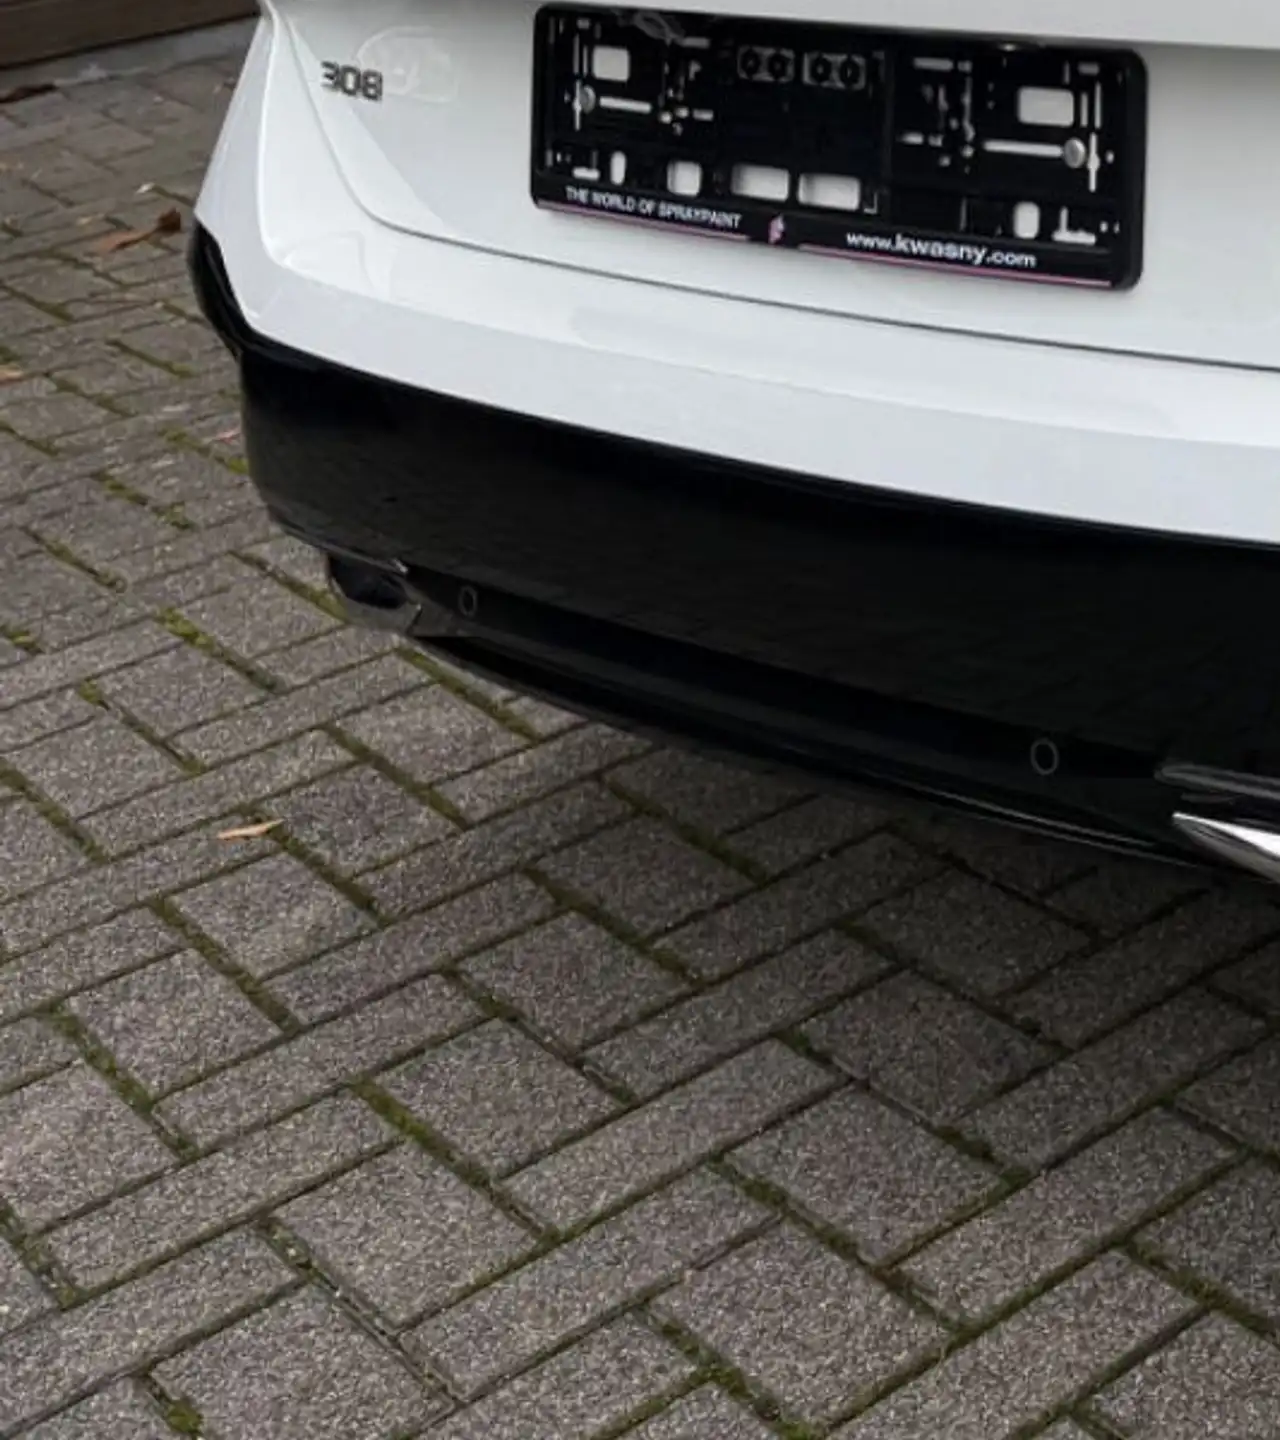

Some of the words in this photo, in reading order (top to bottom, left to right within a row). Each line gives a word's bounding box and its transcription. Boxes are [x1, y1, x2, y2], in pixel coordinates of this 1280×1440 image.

[320, 60, 383, 101] 308
[565, 184, 589, 204] THE
[591, 191, 636, 213] WORLD
[638, 199, 656, 215] OF
[658, 201, 742, 228] SPRAYPAINT
[846, 232, 1037, 268] www.kwasny.com
